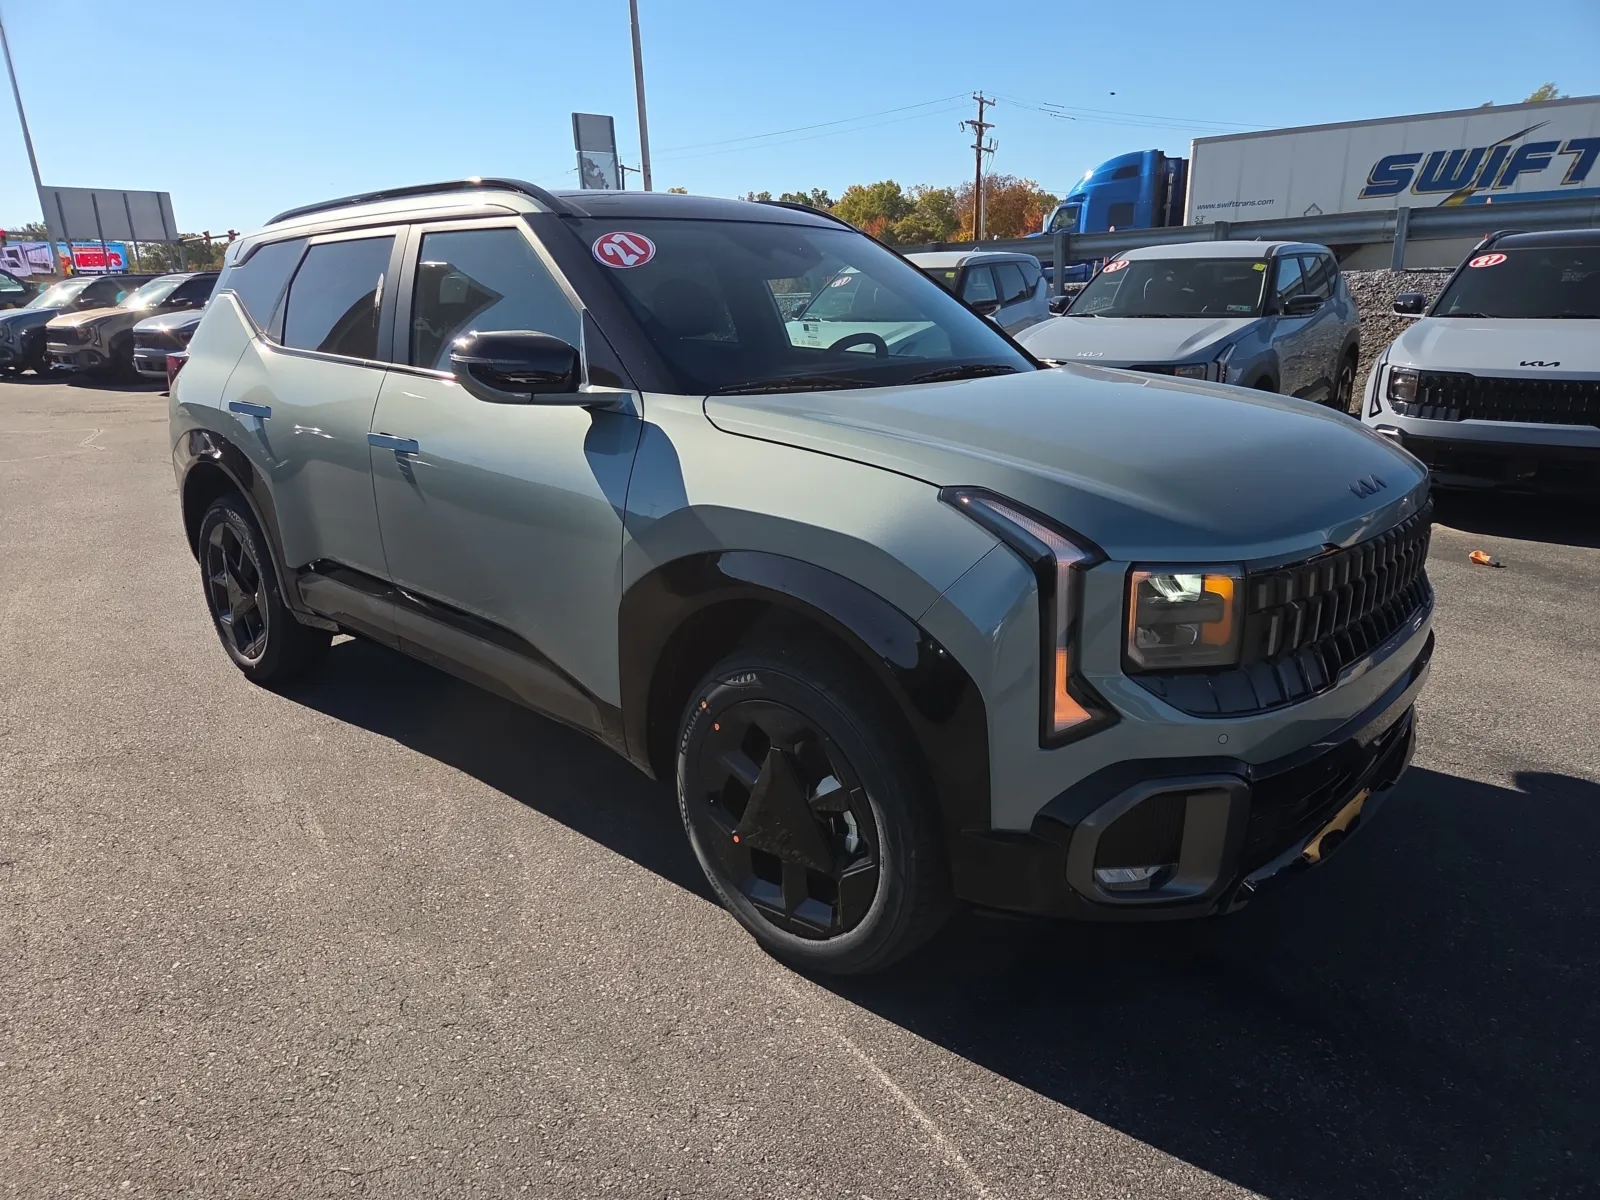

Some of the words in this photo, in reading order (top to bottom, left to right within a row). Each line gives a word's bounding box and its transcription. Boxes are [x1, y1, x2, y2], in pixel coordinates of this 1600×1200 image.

[1358, 137, 1600, 199] SWIFT
[1197, 199, 1274, 210] www.swifttrans.com
[602, 233, 646, 266] 27
[1475, 254, 1502, 267] 27
[1347, 473, 1388, 499] KIA
